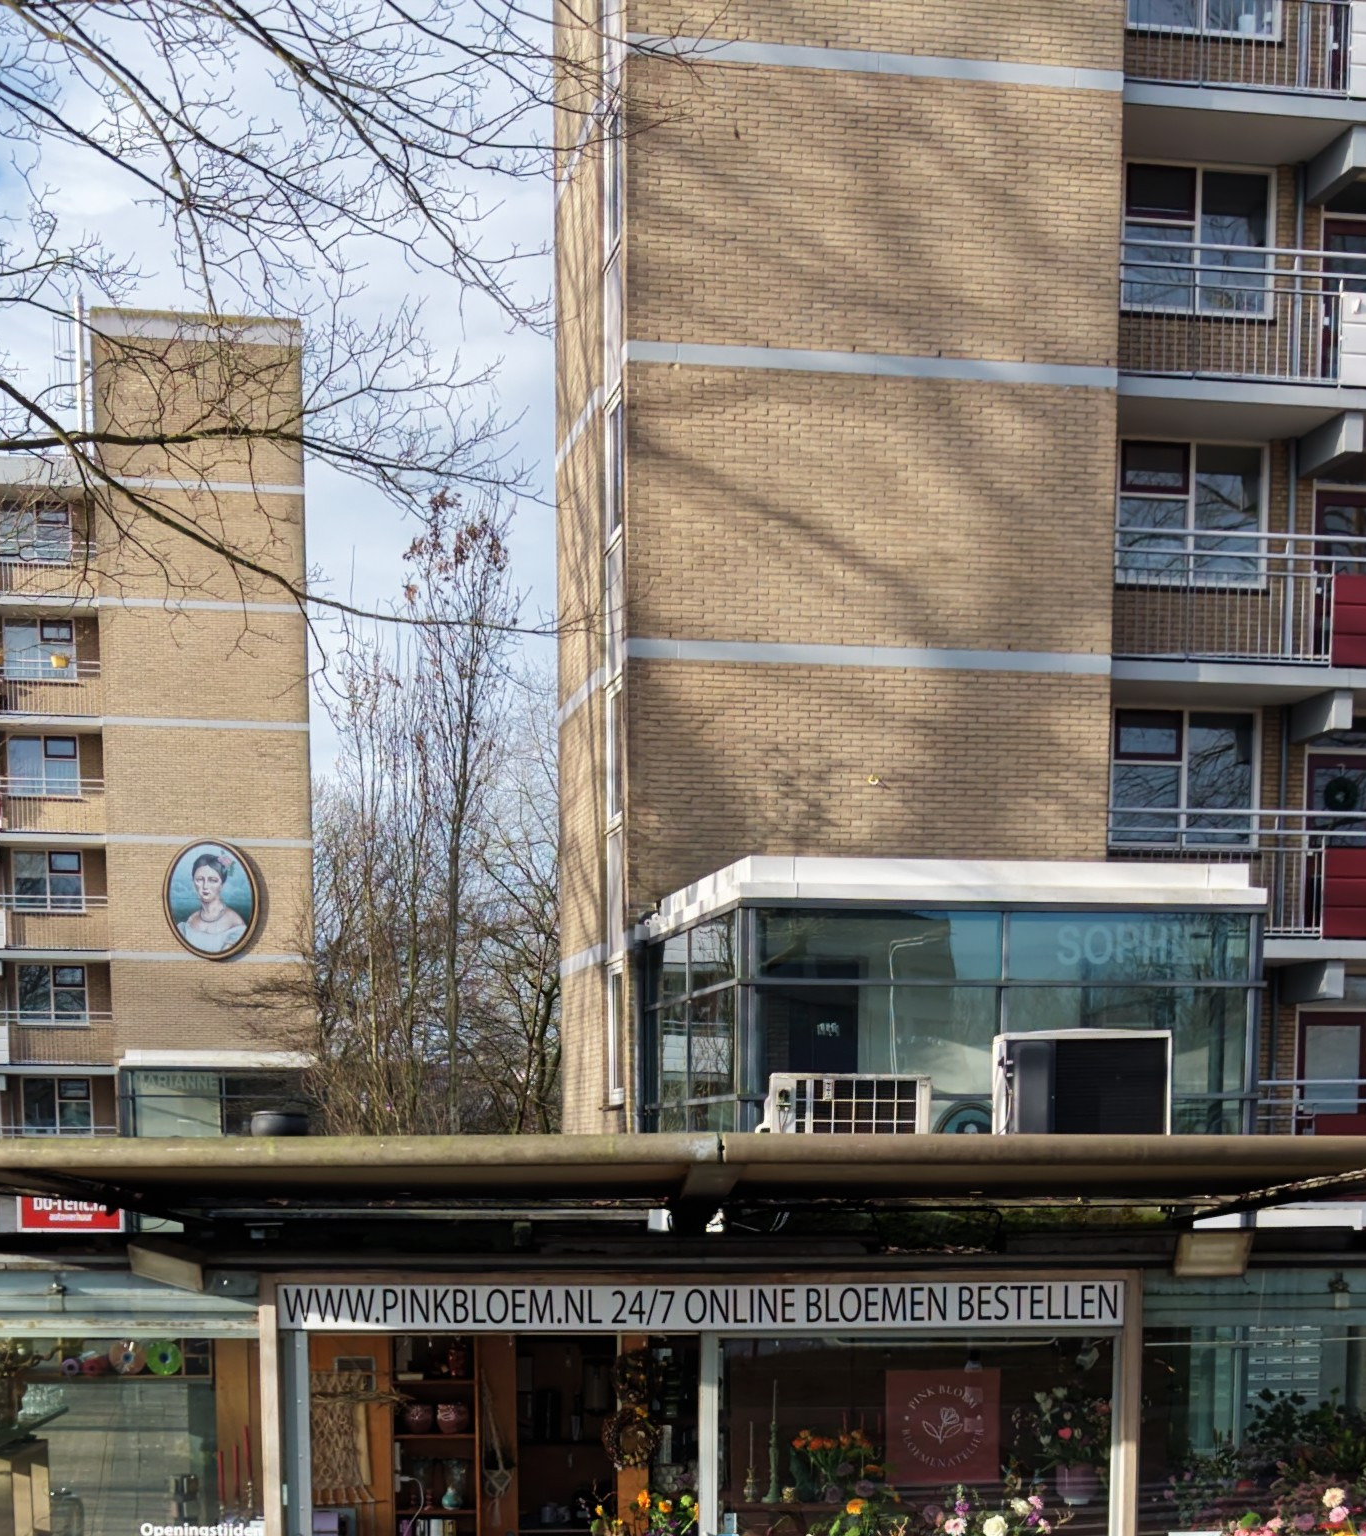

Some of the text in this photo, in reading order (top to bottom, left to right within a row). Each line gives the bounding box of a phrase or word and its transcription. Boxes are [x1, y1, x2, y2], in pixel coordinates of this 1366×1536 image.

[283, 1284, 1118, 1325] WWW.PINKBLOEM.NL 24/7 ONLINE BLOEMEN BESTELLEN
[908, 1385, 978, 1410] PINK BLOEM
